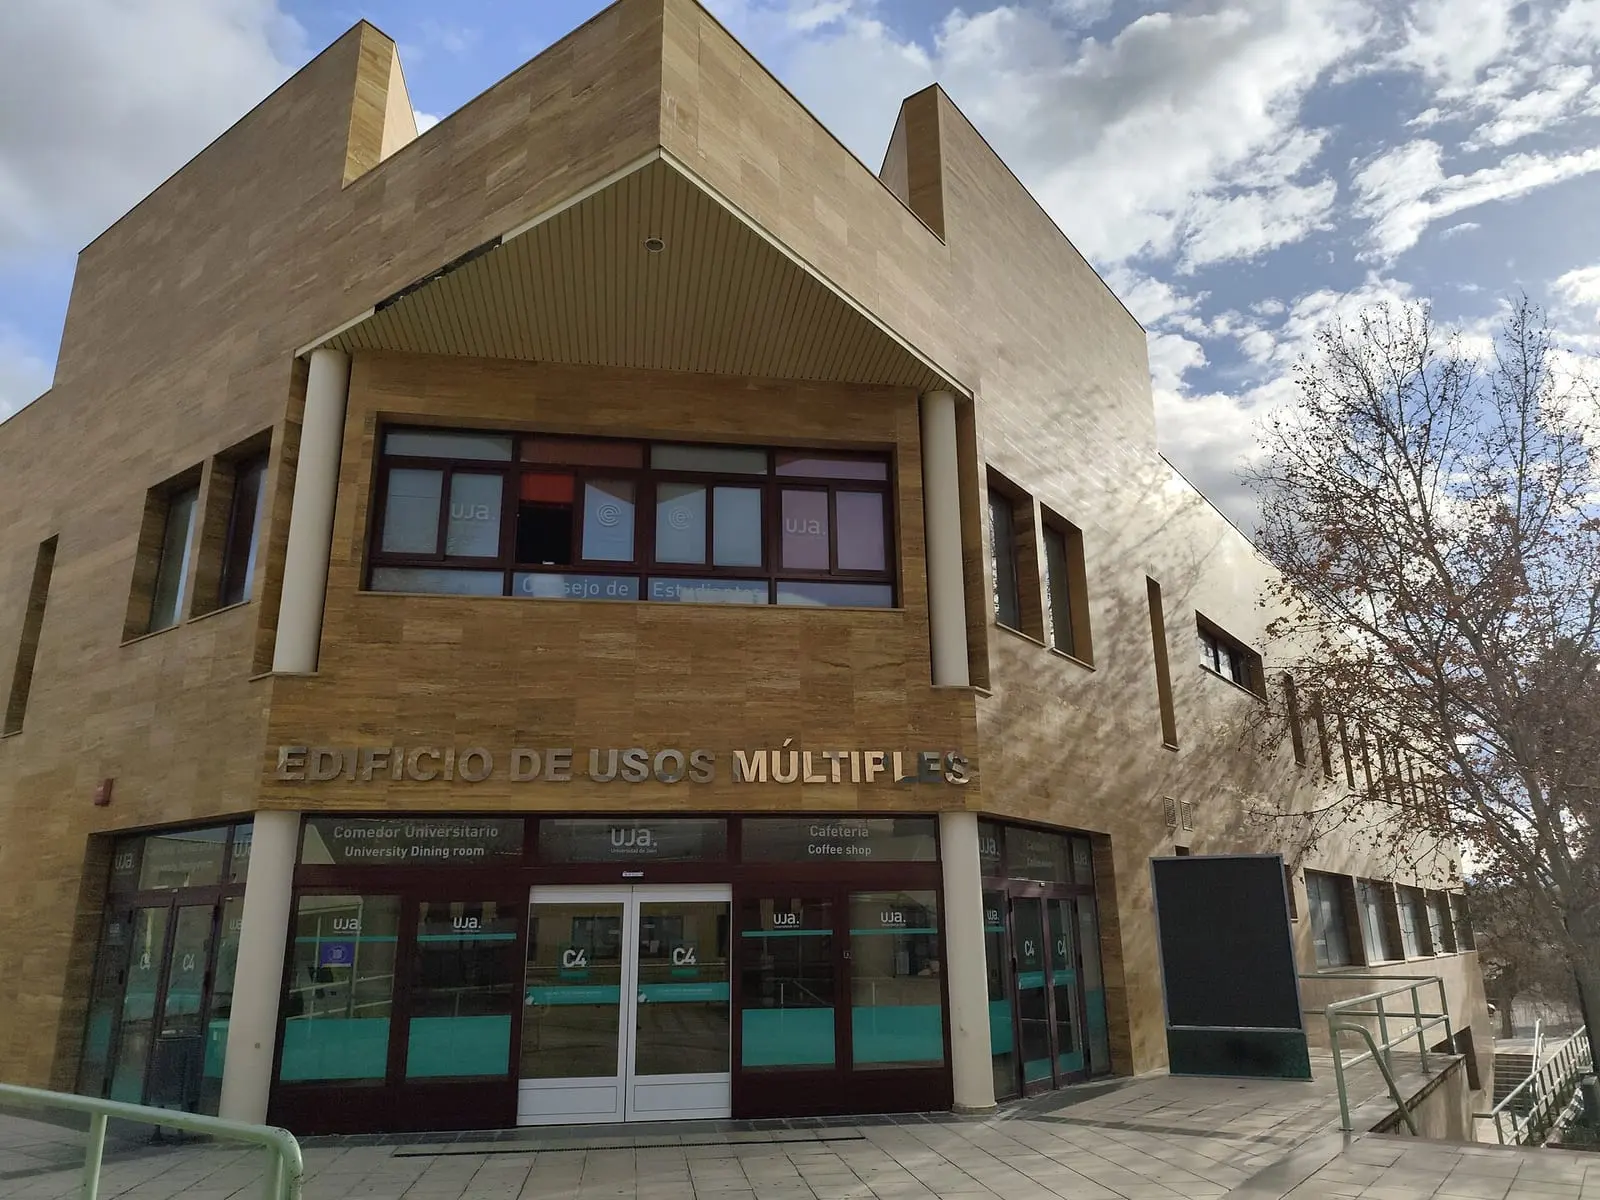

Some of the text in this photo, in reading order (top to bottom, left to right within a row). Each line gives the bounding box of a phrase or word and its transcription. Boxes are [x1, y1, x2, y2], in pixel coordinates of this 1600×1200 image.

[606, 580, 629, 596] de
[276, 738, 970, 785] EDIFICIO DE USOS MÚLTIPLES
[334, 825, 499, 839] Comedor Universitario
[345, 846, 485, 859] University Dining room
[808, 844, 872, 857] Coffee shop
[562, 949, 587, 968] C4
[673, 948, 697, 965] C4
